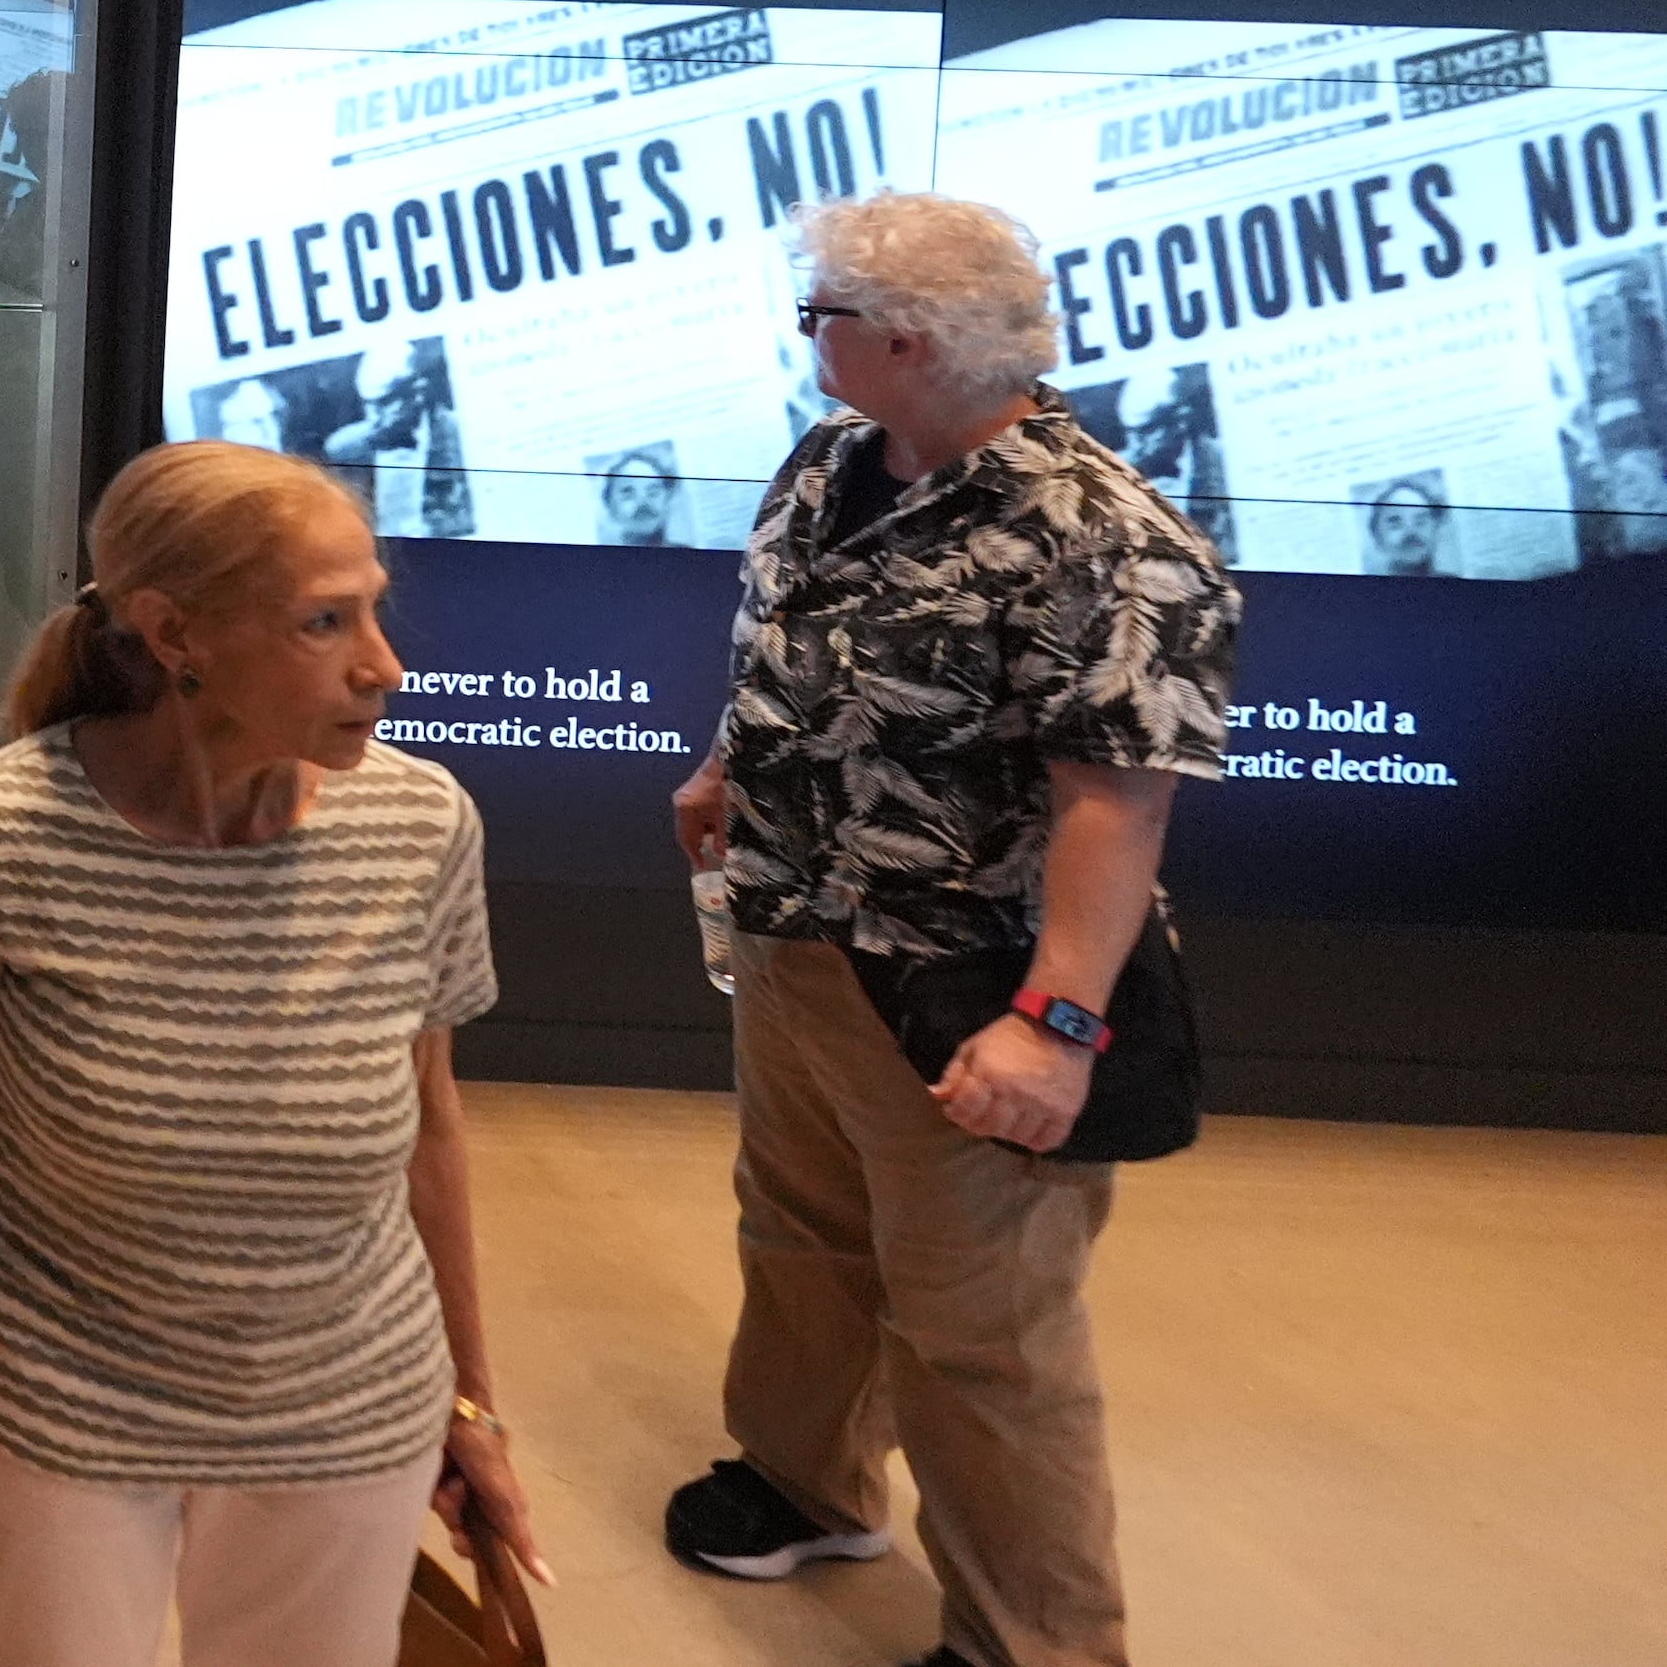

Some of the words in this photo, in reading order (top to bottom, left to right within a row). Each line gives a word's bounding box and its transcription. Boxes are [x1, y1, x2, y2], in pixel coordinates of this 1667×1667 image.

[625, 9, 767, 60] PRIMERA
[1399, 32, 1544, 83] PRIMERA
[201, 135, 723, 361] ELECCIONES,
[746, 87, 889, 229] NO!
[1055, 163, 1497, 367] ECCIONES,
[1522, 110, 1667, 254] NO!
[399, 670, 494, 695] never
[502, 670, 536, 698] to
[544, 667, 622, 702] hold
[630, 680, 650, 704] a
[369, 717, 541, 747] emocratic
[550, 716, 692, 754] election.
[1263, 702, 1300, 730] to
[1306, 698, 1387, 734] hold
[1394, 711, 1417, 735] a
[1311, 748, 1458, 786] election.
